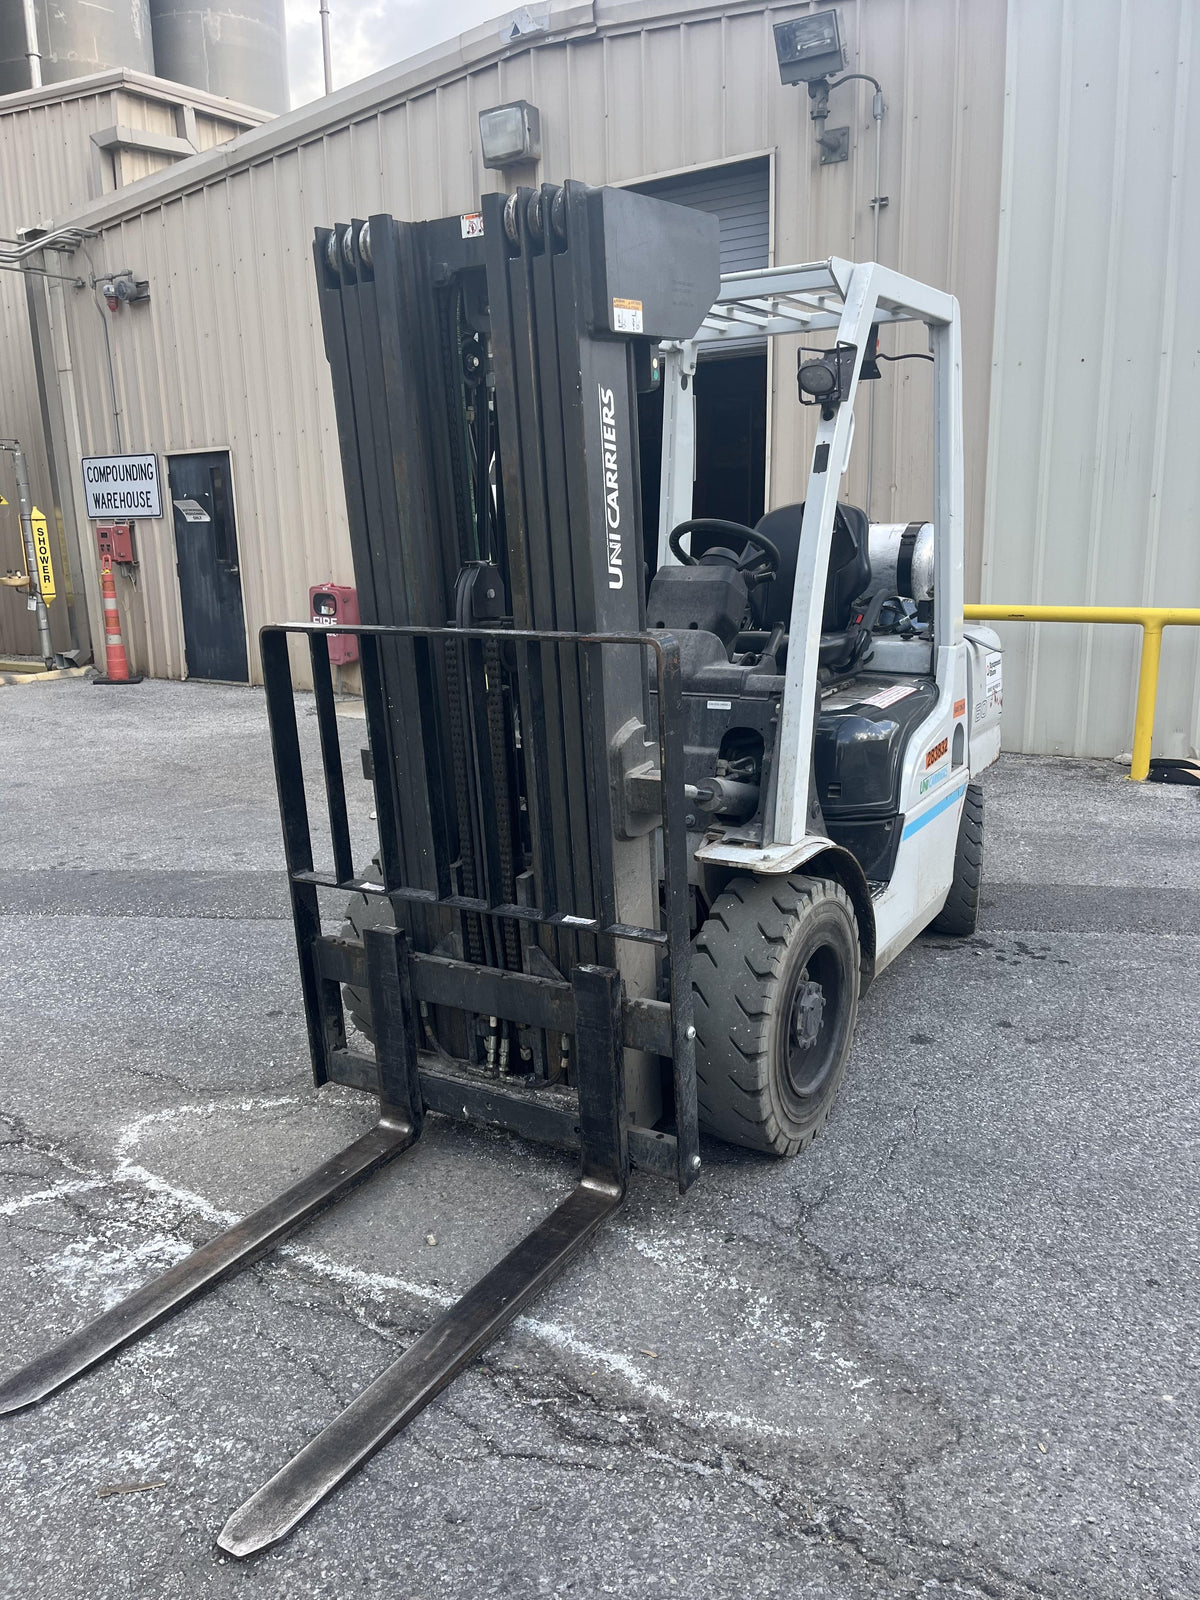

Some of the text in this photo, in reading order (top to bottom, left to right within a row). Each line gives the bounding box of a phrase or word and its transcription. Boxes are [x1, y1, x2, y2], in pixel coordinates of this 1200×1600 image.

[87, 463, 154, 483] COMPOUNDING
[601, 387, 624, 590] UNICARRIERS
[93, 491, 153, 509] WAREHOUSE
[37, 527, 51, 583] SHOWER
